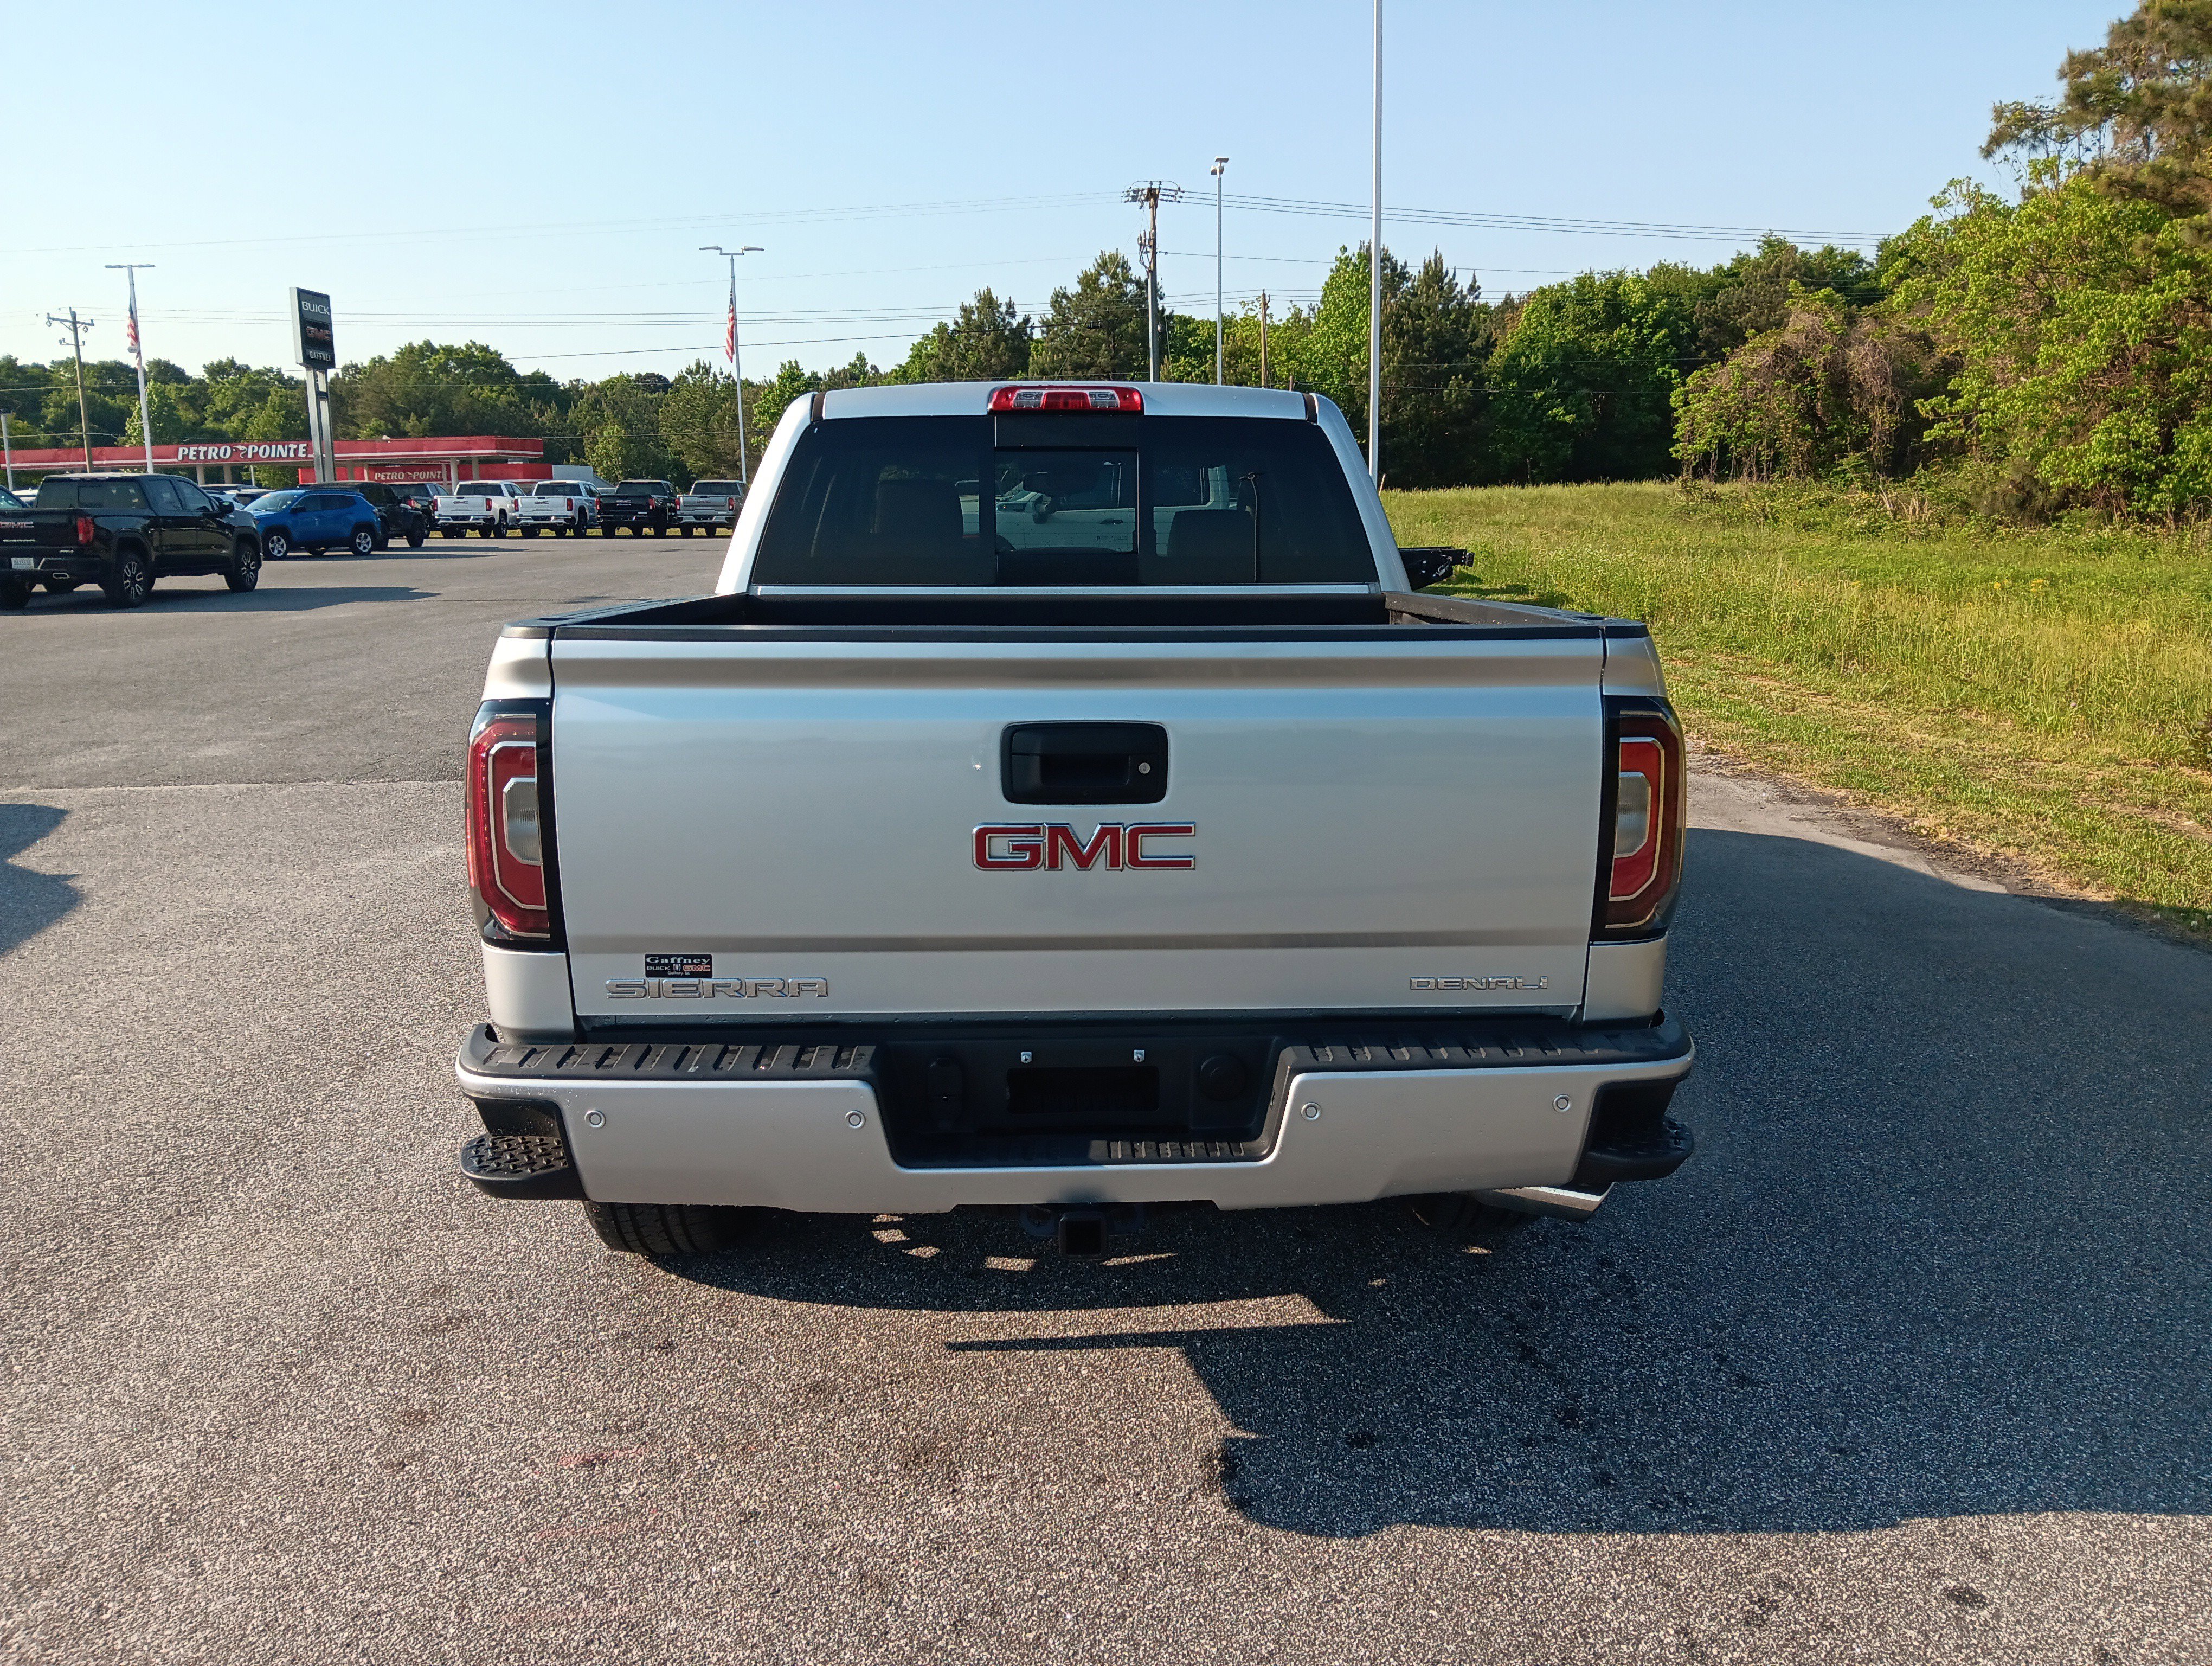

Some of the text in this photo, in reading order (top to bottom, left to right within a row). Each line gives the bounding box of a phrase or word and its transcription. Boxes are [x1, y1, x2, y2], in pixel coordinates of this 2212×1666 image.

[301, 301, 330, 315] BUICK
[306, 326, 331, 341] GMC
[178, 444, 308, 461] PETRO POINTE
[374, 471, 442, 480] PETRO POINT
[971, 821, 1196, 871] GMC
[646, 957, 710, 965] Gaffney
[606, 978, 828, 999] SIERRA
[1410, 976, 1548, 990] DENALI
